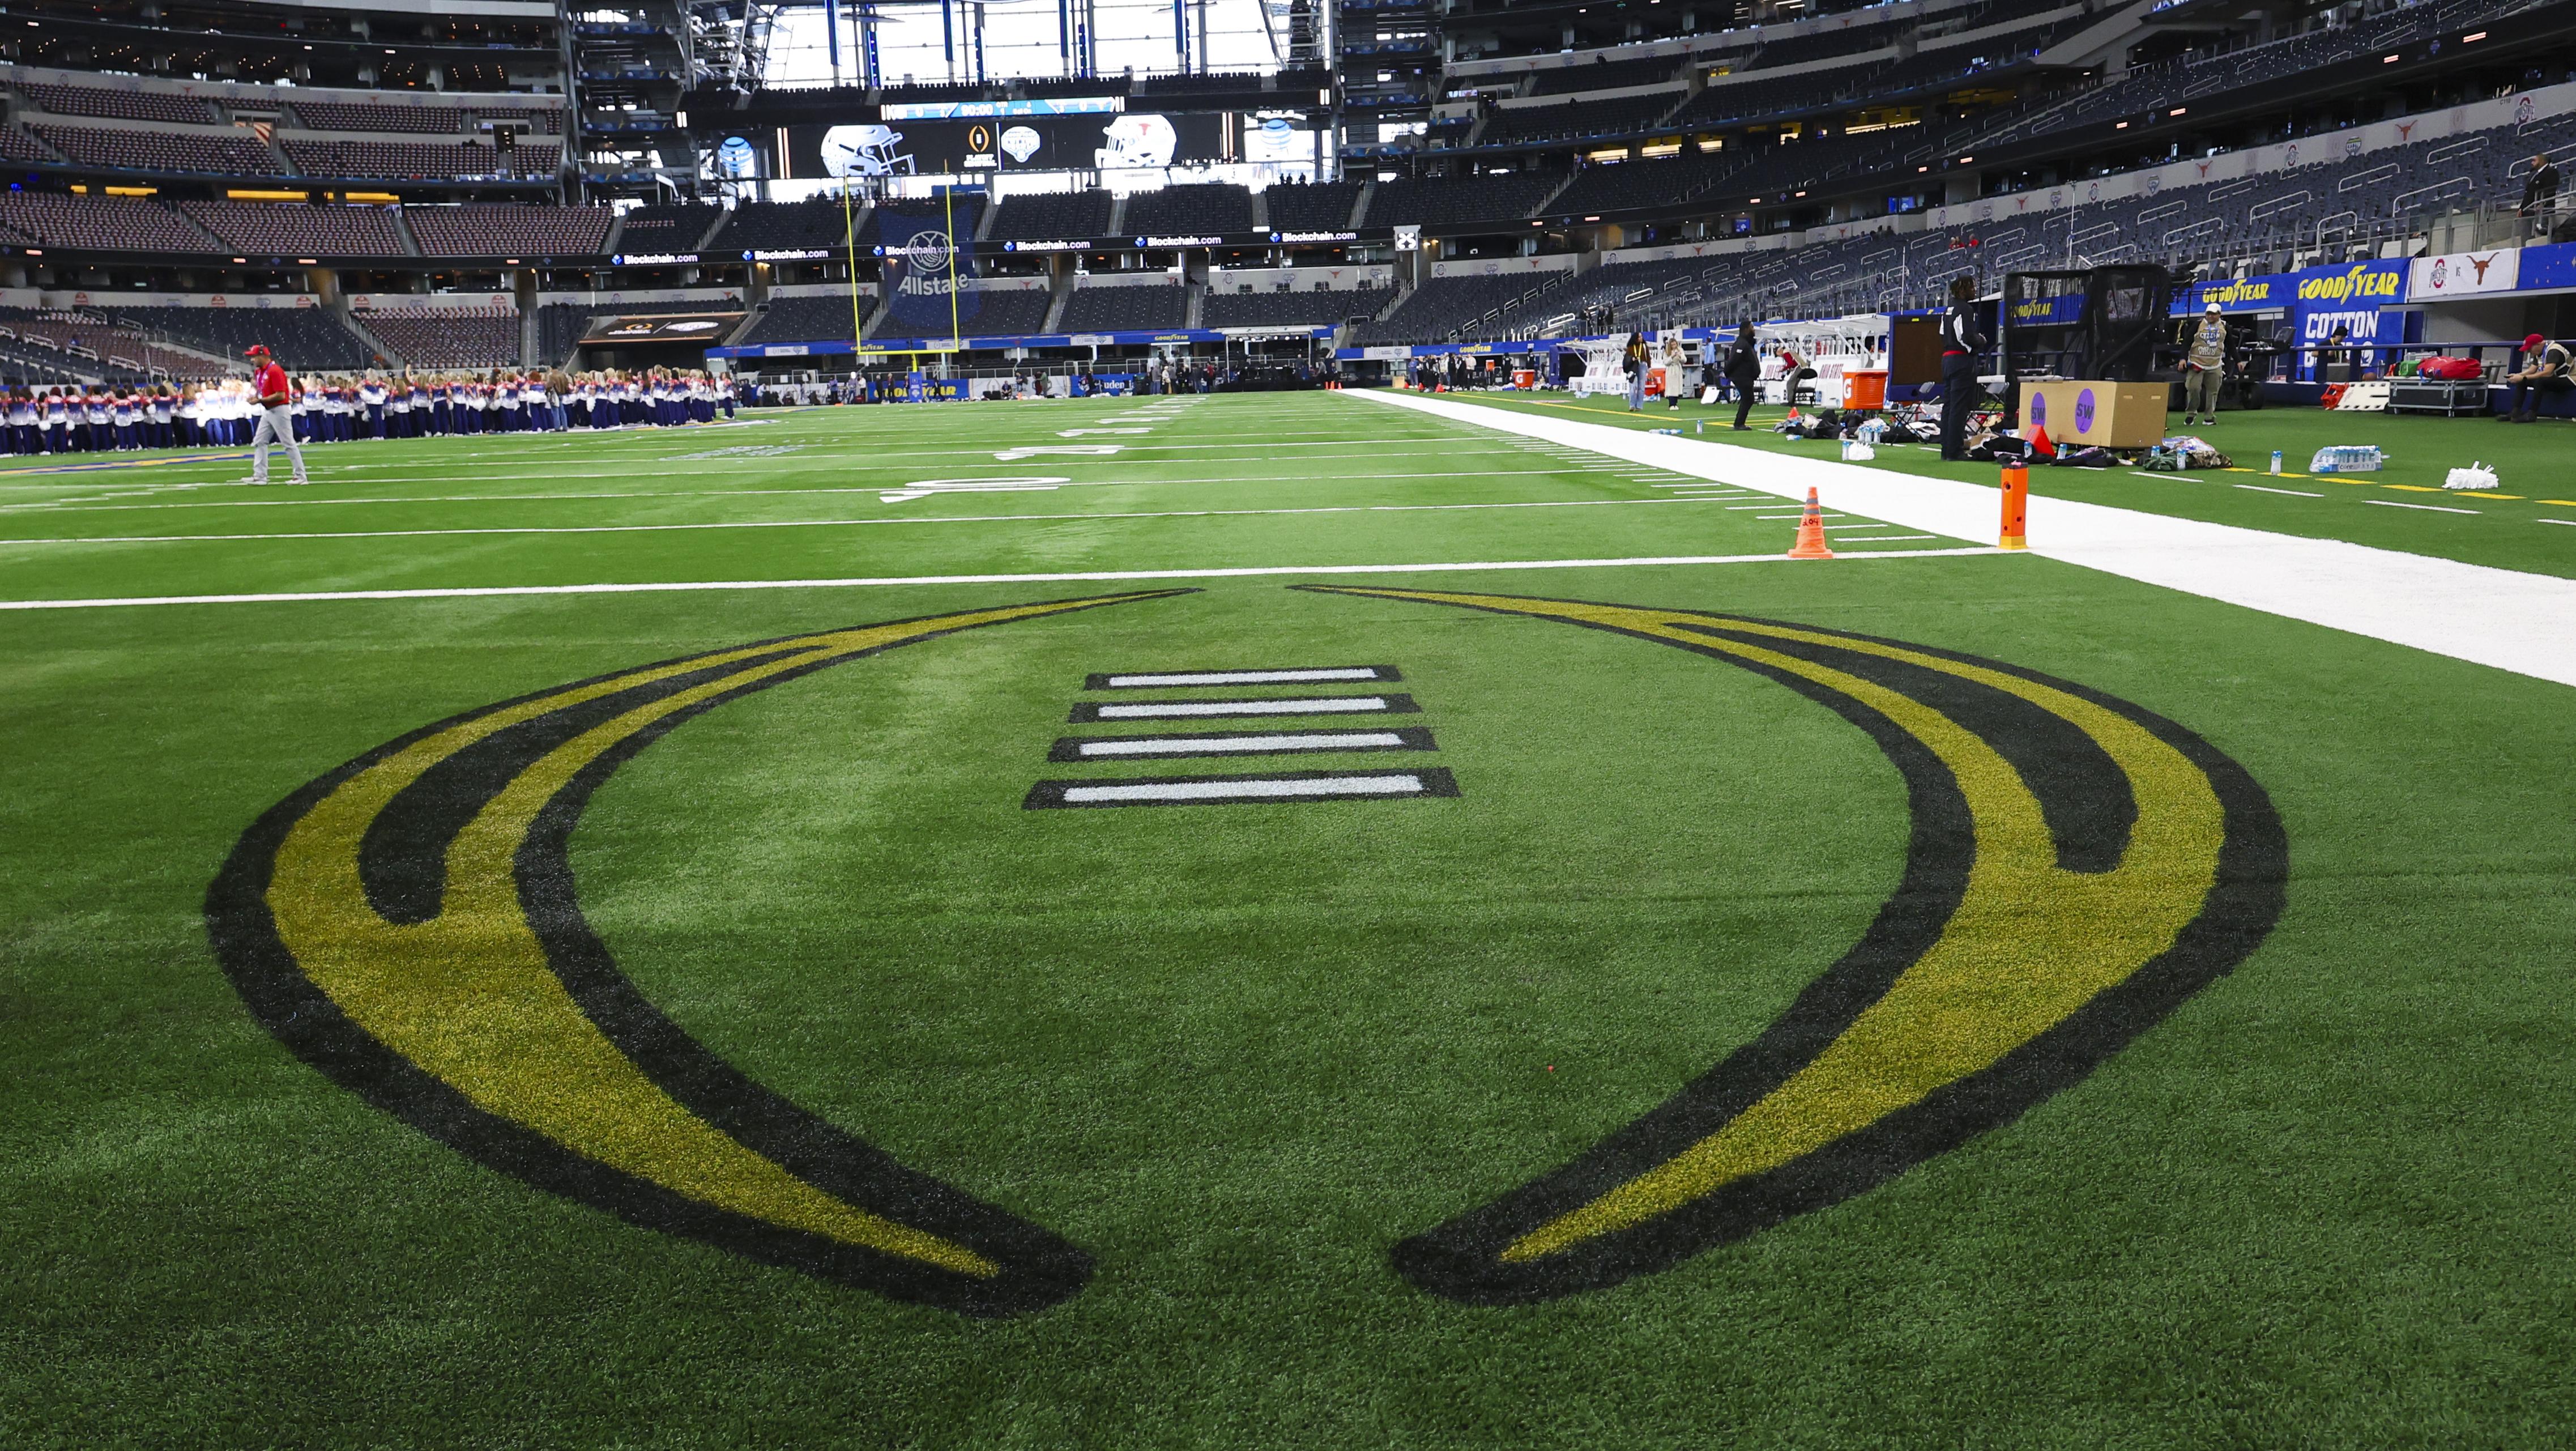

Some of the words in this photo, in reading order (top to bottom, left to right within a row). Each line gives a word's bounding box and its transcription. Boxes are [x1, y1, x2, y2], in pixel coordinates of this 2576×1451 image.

[961, 104, 993, 116] 90:00
[1147, 236, 1221, 246] Blockchain.com
[1282, 231, 1357, 242] Blockchain.com
[1016, 240, 1090, 251] Blockchain.com
[624, 254, 698, 265] Blockchain.com
[754, 250, 828, 260] Blockchain.com
[898, 273, 969, 296] Allstate
[2298, 265, 2399, 305] GOODYEAR
[2203, 279, 2270, 307] GOODYEAR
[2305, 310, 2379, 339] COTTON
[1154, 333, 1188, 342] GOODYEAR
[1459, 343, 1491, 354] GOODYEAR
[1844, 378, 1852, 399] G
[2032, 407, 2045, 420] SW
[2075, 403, 2094, 420] SW
